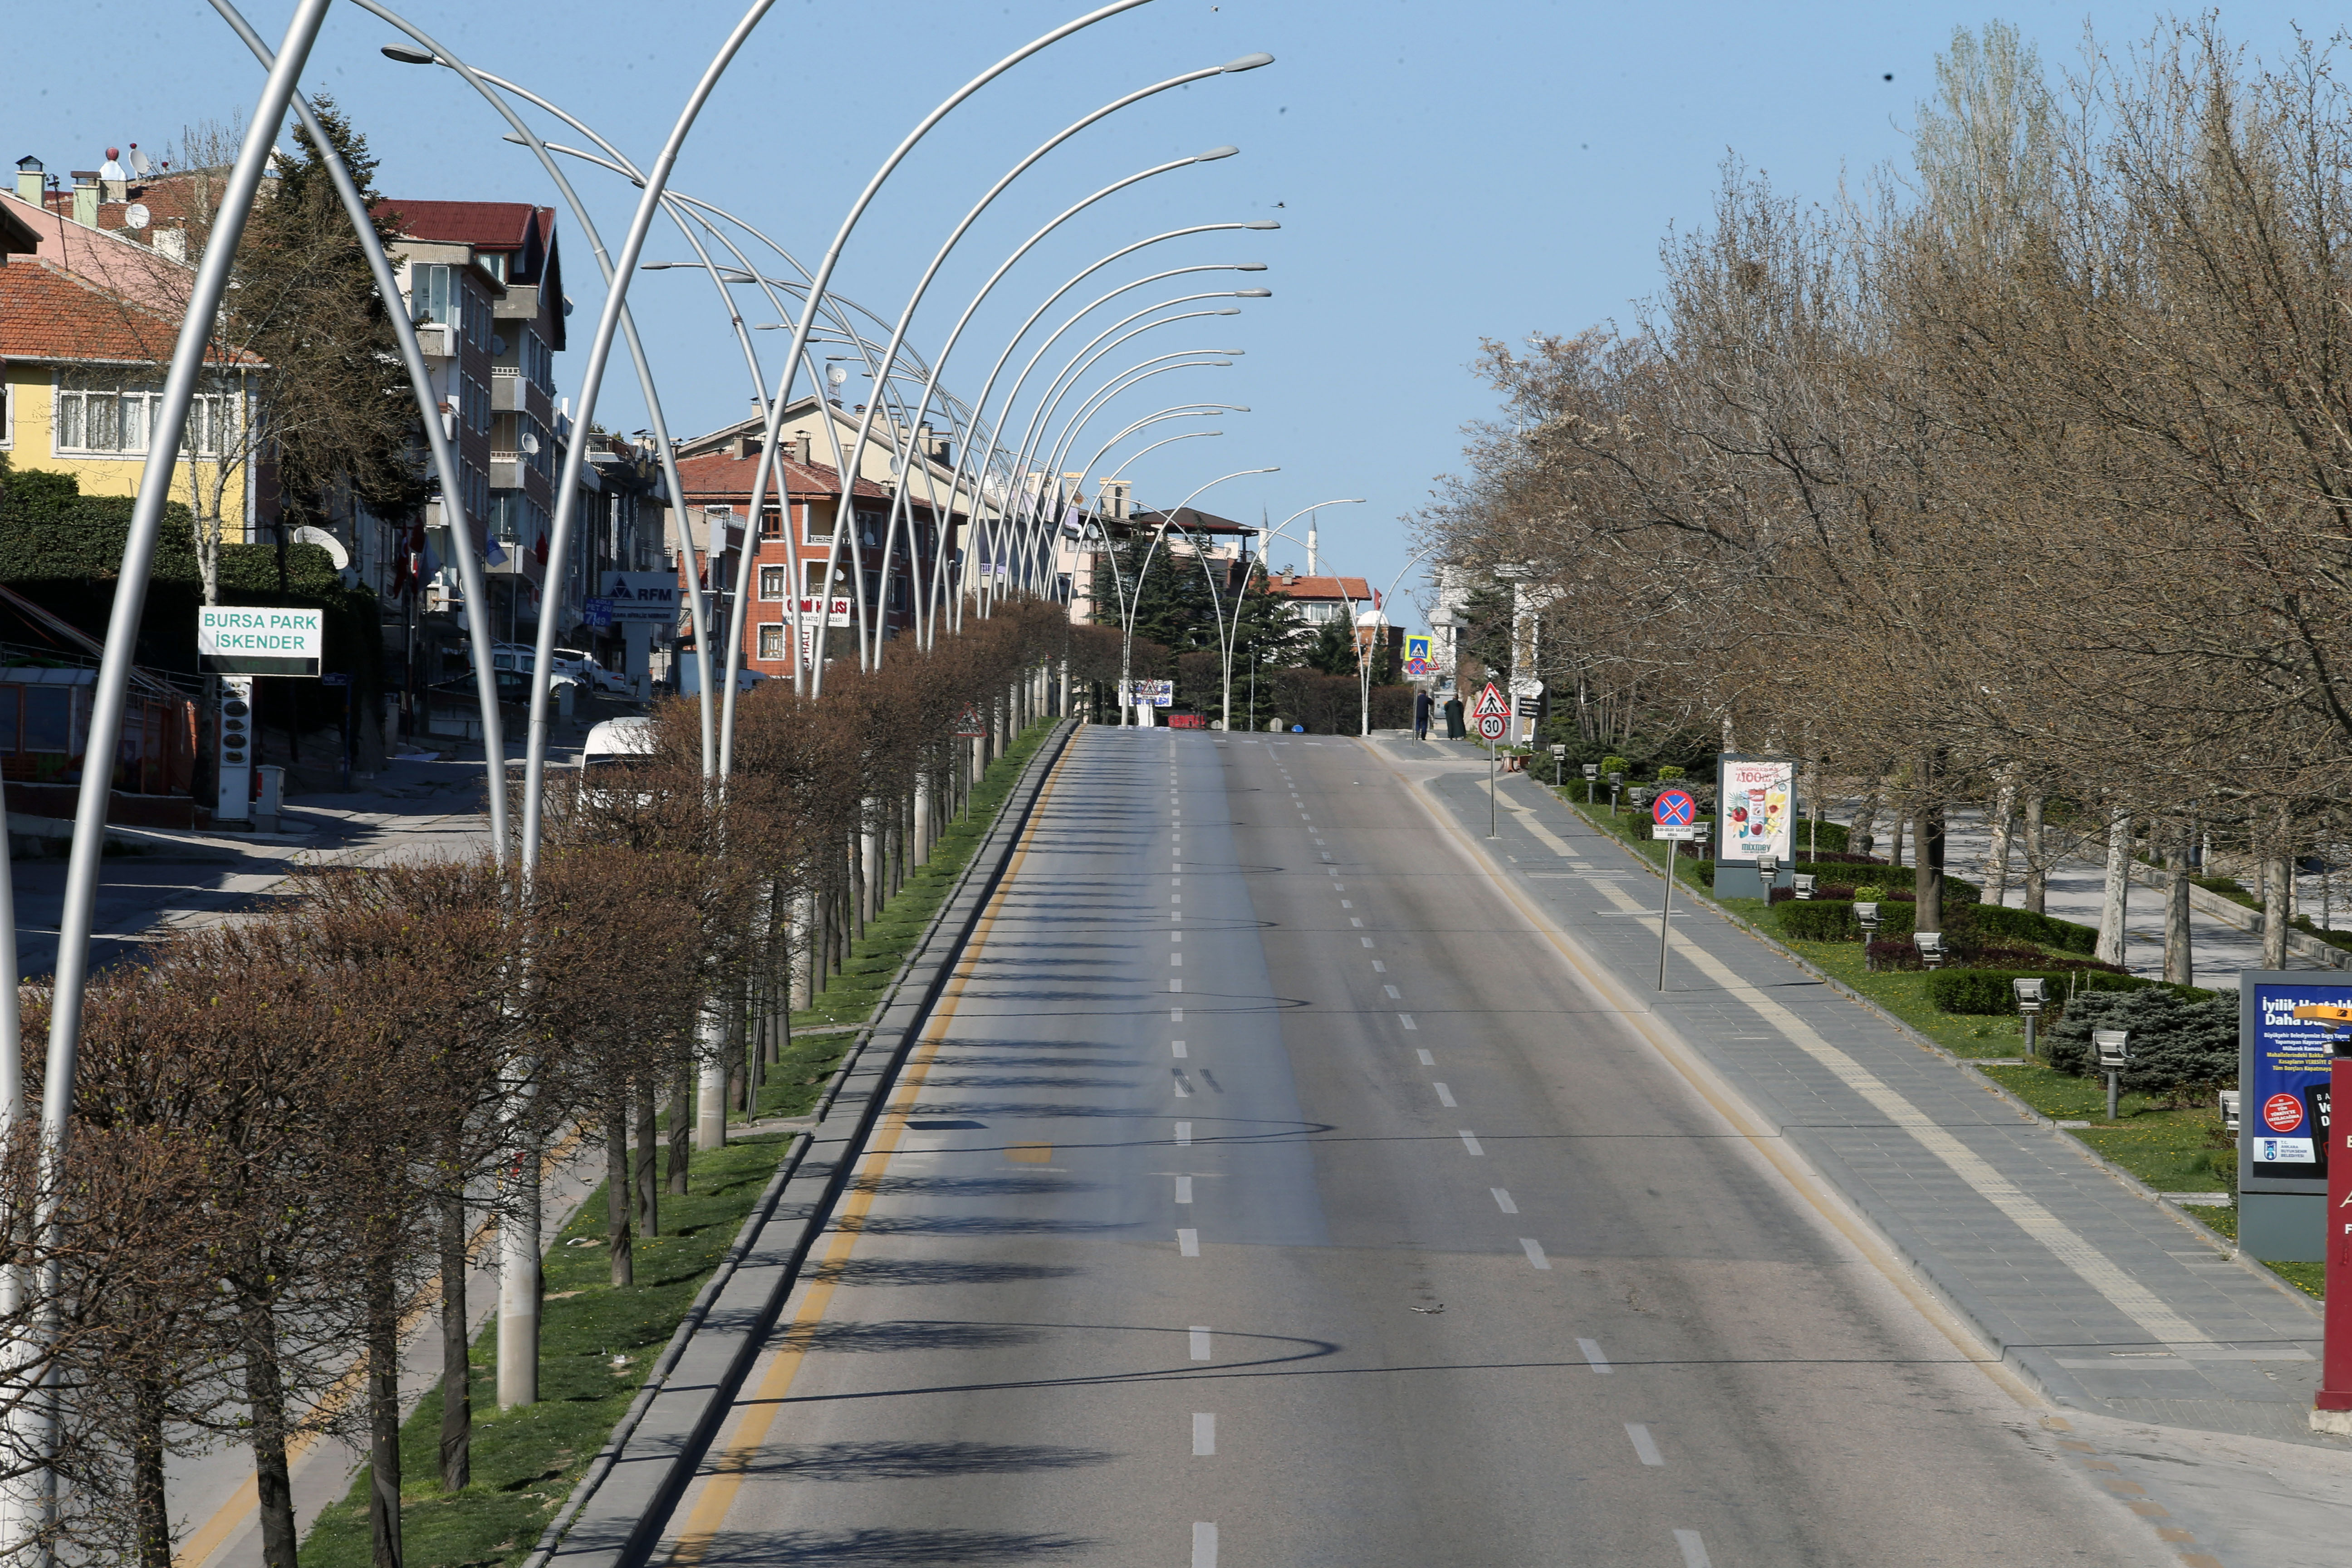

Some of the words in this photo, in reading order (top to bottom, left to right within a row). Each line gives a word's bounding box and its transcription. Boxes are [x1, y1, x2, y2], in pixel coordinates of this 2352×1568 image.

[637, 588, 671, 601] RFM
[204, 613, 265, 628] BURSA
[270, 615, 318, 629] PARK
[216, 631, 305, 649] İSKENDER
[1485, 720, 1499, 733] 30
[1742, 843, 1771, 852] mixmey
[2262, 996, 2297, 1014] İyilik
[2265, 1013, 2301, 1025] Daha
